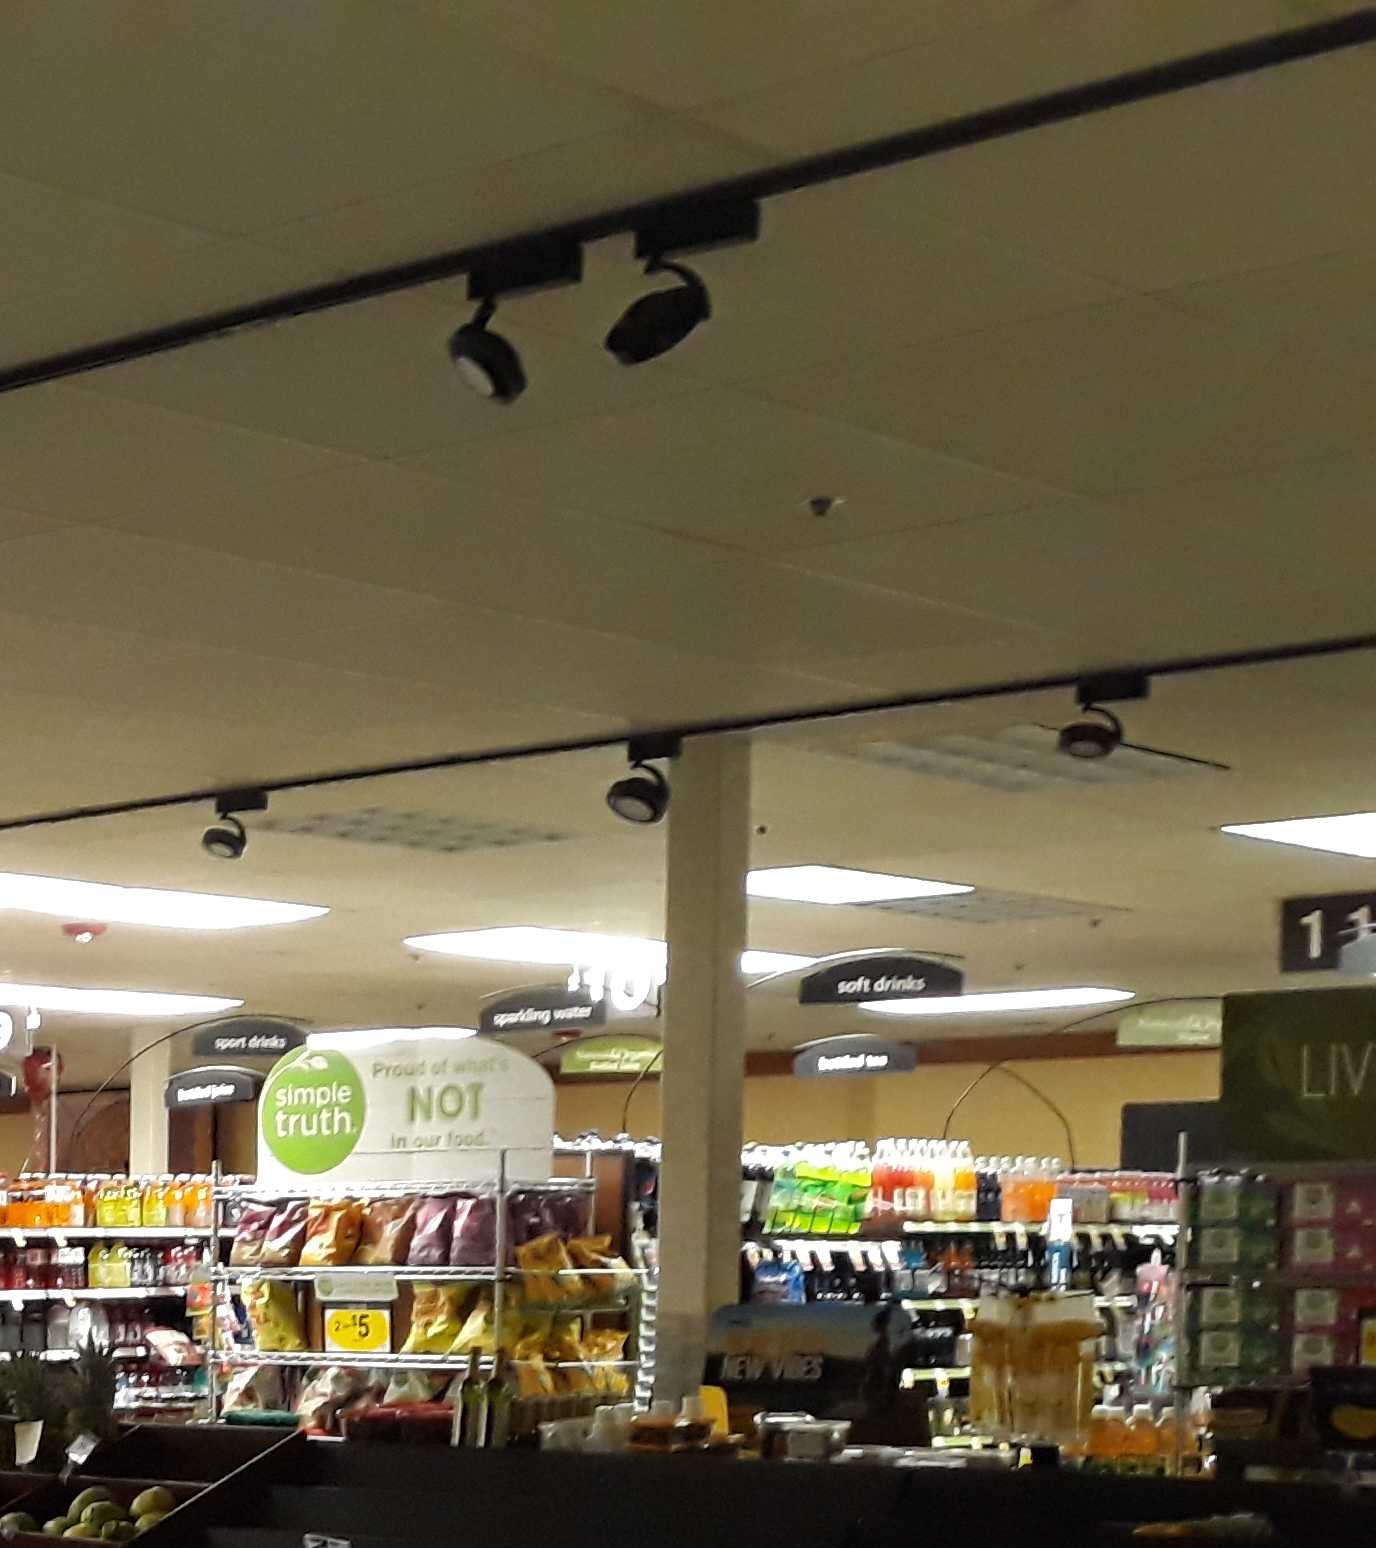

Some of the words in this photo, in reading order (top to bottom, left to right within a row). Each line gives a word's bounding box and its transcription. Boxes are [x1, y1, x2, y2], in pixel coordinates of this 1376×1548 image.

[838, 976, 870, 994] soft
[872, 974, 925, 992] drinks
[494, 1008, 551, 1027] sparkling
[553, 1006, 592, 1020] water
[215, 1036, 247, 1051] sport
[248, 1033, 286, 1049] drinks
[373, 1061, 424, 1078] Proud
[431, 1059, 447, 1075] of
[275, 1082, 352, 1109] simple
[406, 1083, 484, 1122] NOT
[414, 1136, 443, 1148] our
[352, 1314, 369, 1337] $5
